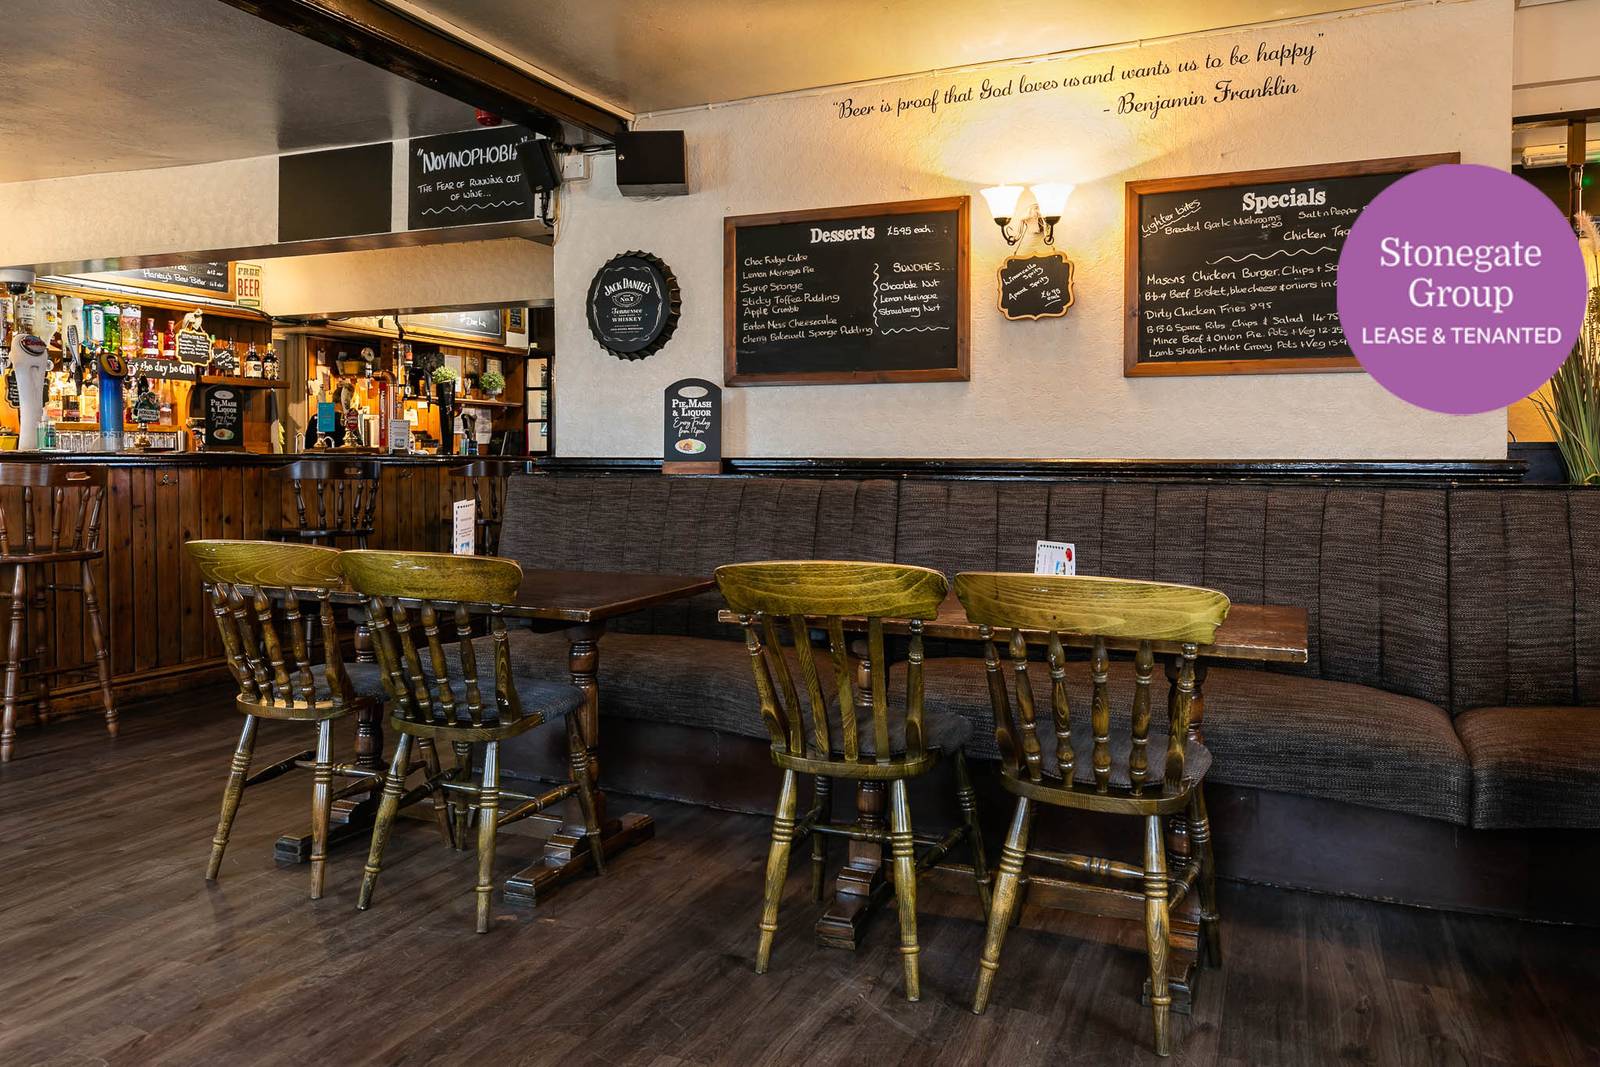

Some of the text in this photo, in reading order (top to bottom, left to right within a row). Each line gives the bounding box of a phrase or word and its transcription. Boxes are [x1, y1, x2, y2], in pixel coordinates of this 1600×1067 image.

[880, 99, 892, 113] is
[897, 89, 939, 117] proof
[944, 85, 974, 104] that
[979, 78, 1013, 100] God
[1019, 74, 1059, 94] loves
[1063, 76, 1080, 87] us
[1082, 66, 1115, 86] and
[1121, 60, 1171, 80] wants
[1178, 60, 1199, 72] us
[1205, 54, 1224, 69] to
[1230, 44, 1250, 66] be
[1117, 91, 1207, 120] Benjamin
[1214, 75, 1299, 103] Franklin
[417, 184, 433, 194] THE
[436, 181, 455, 191] FEAR
[456, 180, 465, 189] OF
[505, 173, 522, 184] OUT
[450, 193, 461, 201] OF
[1242, 187, 1327, 215] Specials
[1141, 199, 1201, 234] Lighter bites
[1298, 210, 1322, 220] Salt
[1330, 206, 1358, 216] Pepper
[1164, 221, 1200, 235] Breaded
[1233, 214, 1282, 226] Mushrooms
[810, 225, 875, 244] Desserts
[1283, 228, 1327, 241] Chicken
[744, 253, 808, 266] Choc Fudge Cake
[237, 267, 260, 277] FREE
[743, 265, 815, 280] Lemon Meringue Pie
[1146, 273, 1186, 286] Masons
[1192, 269, 1236, 282] Chicken
[1281, 265, 1315, 276] Chips
[237, 278, 260, 298] BEER
[604, 277, 652, 297] JACK DANIEL'S
[740, 282, 803, 294] Syrup Sponge
[879, 278, 941, 291] Chocolate Nut
[742, 292, 840, 307] Sticky Toffee Pudding
[880, 293, 938, 304] Lemon Meringue
[1169, 288, 1191, 299] Beef
[743, 307, 769, 318] Apple
[878, 304, 941, 318] Strawberry Nut
[1144, 308, 1172, 320] Dirty
[1173, 304, 1216, 317] Chicken
[1219, 303, 1246, 314] Fries
[767, 320, 786, 329] Mess
[788, 314, 837, 328] Cheesecake
[1175, 323, 1202, 333] Spare
[1232, 319, 1258, 328] Chips
[1273, 313, 1304, 325] Salad
[742, 325, 873, 344] Cherry Bakewell Sponge Pudding
[1153, 337, 1178, 346] Mince
[1182, 334, 1204, 344] Beef
[1213, 333, 1242, 342] Onion
[1268, 327, 1289, 337] Pots
[1149, 348, 1174, 358] Lamb
[1175, 345, 1207, 355] Shank
[1219, 344, 1241, 352] Mint
[1277, 340, 1298, 349] Pots
[141, 361, 153, 372] the
[154, 361, 168, 376] day
[673, 417, 711, 430] Every Friday
